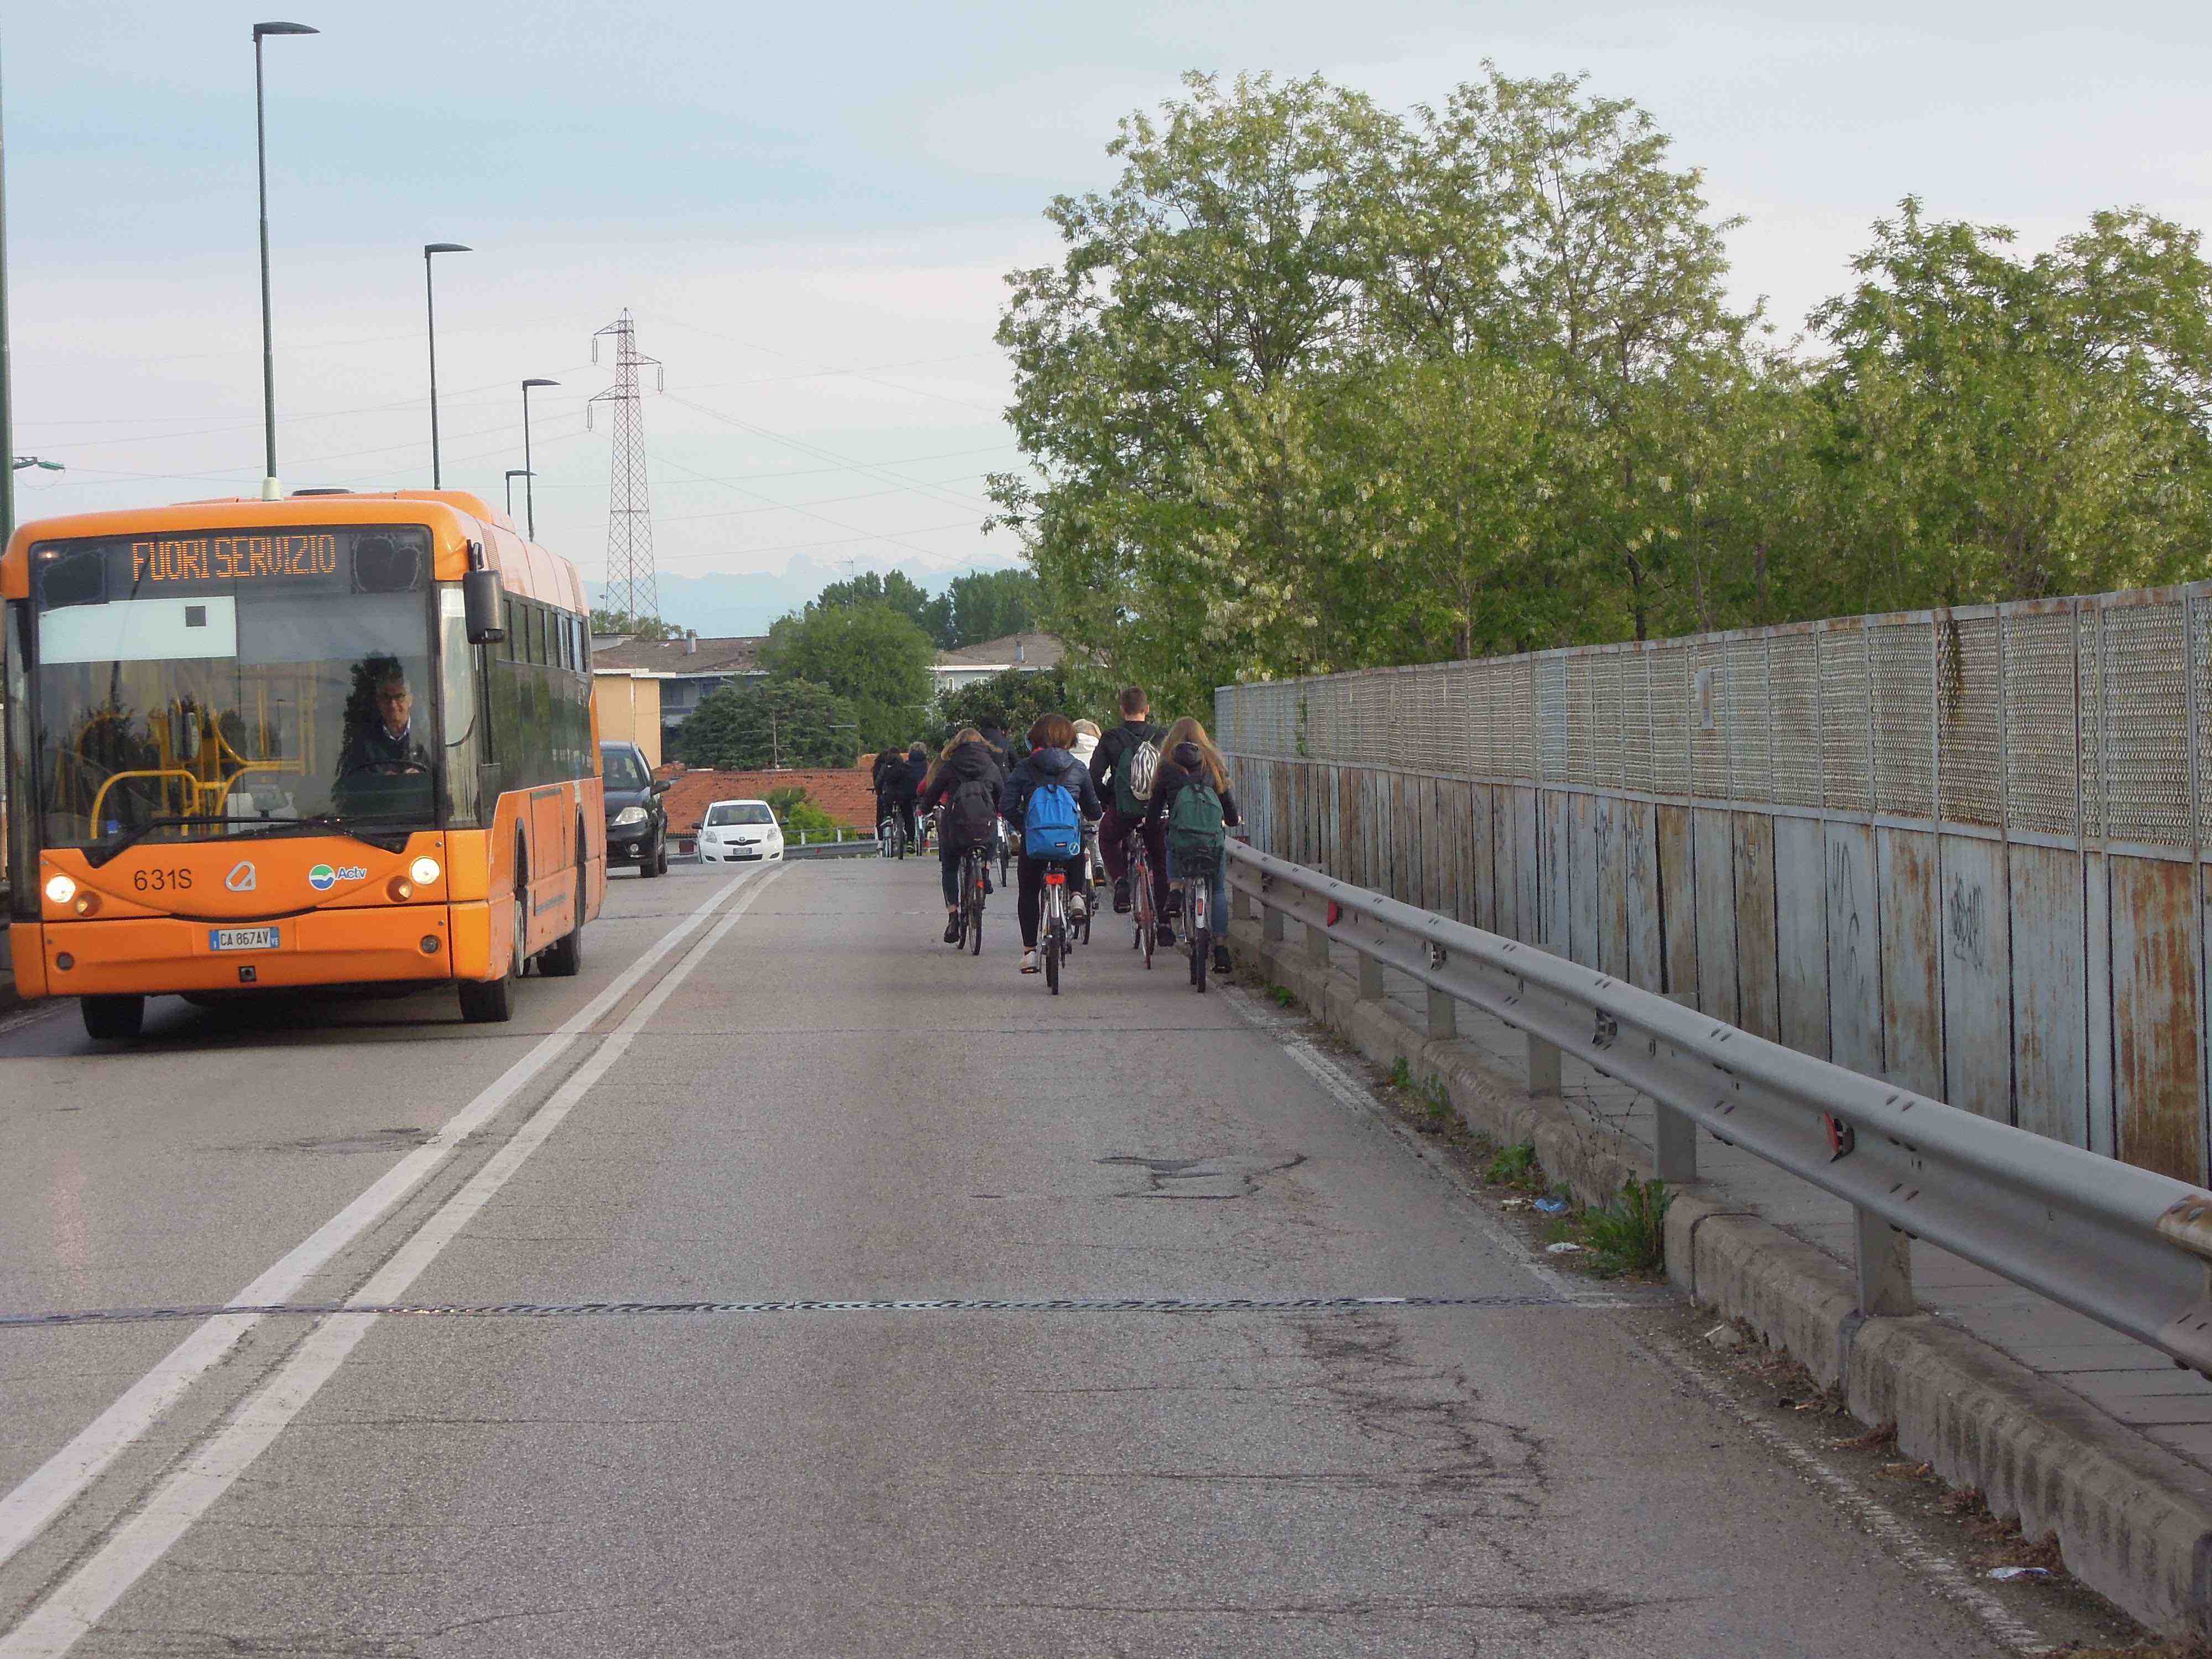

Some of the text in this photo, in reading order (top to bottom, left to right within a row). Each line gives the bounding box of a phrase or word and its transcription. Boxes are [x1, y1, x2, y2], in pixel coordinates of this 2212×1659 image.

[132, 535, 336, 581] FUORI SERVIZIO
[134, 868, 192, 891] 631S
[336, 866, 367, 879] Actv
[221, 933, 233, 946] CA
[236, 931, 269, 945] 867AV
